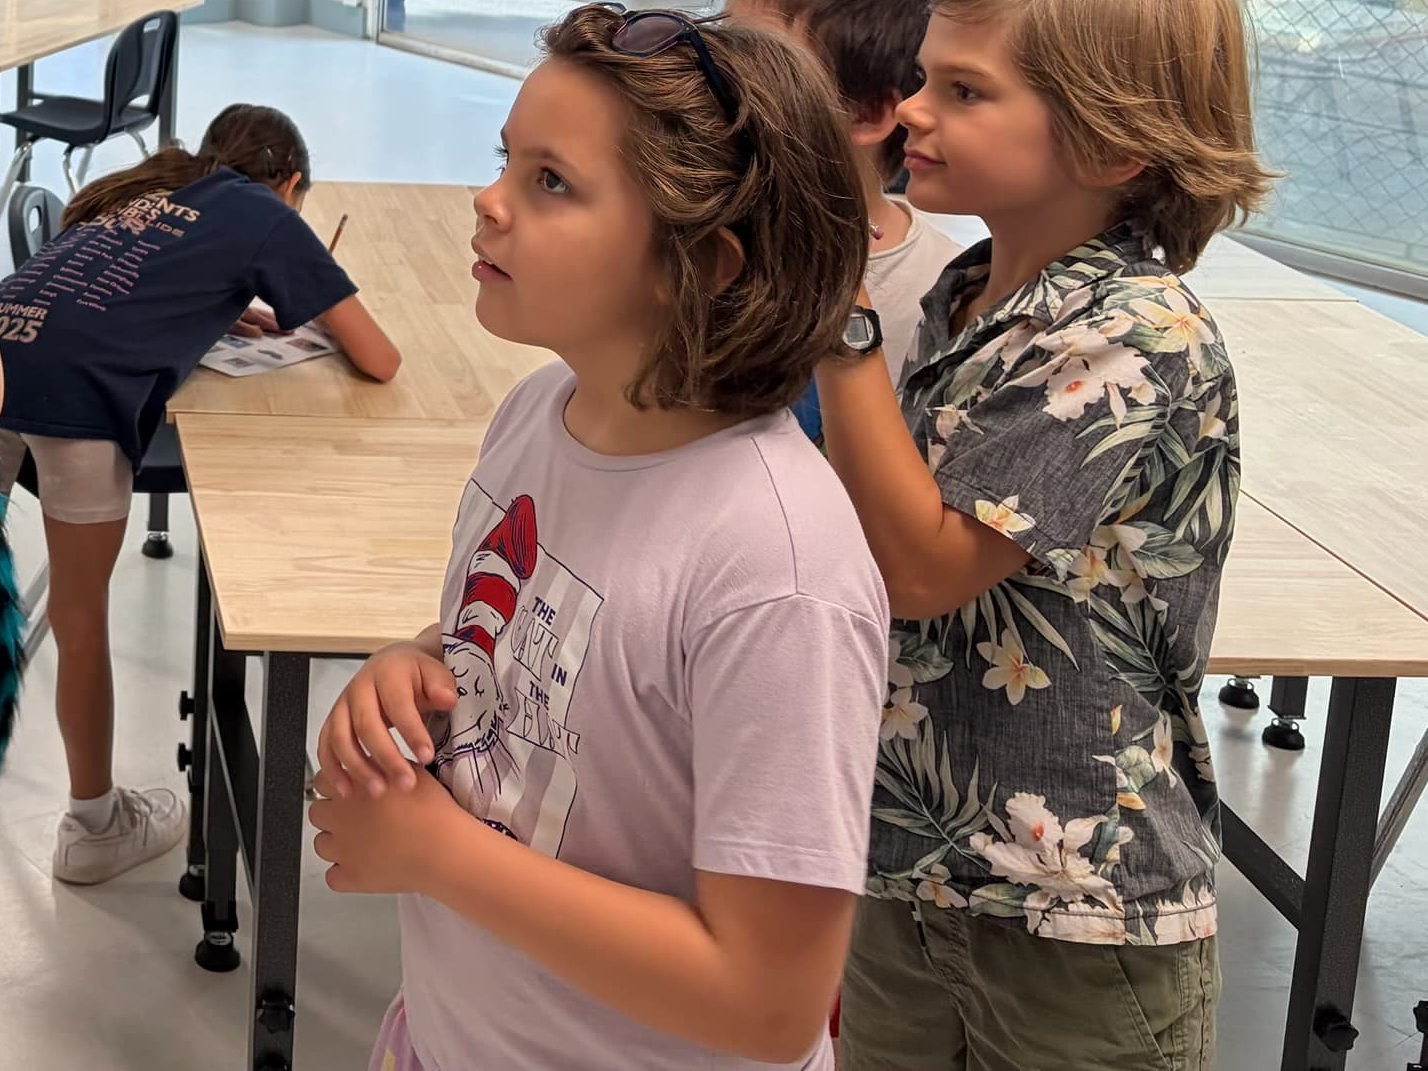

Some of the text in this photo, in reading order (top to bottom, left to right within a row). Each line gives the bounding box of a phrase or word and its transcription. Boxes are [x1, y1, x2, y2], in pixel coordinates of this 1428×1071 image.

[532, 596, 556, 626] THE
[510, 605, 559, 682] CAT
[550, 663, 567, 687] IN
[529, 681, 550, 711] THE
